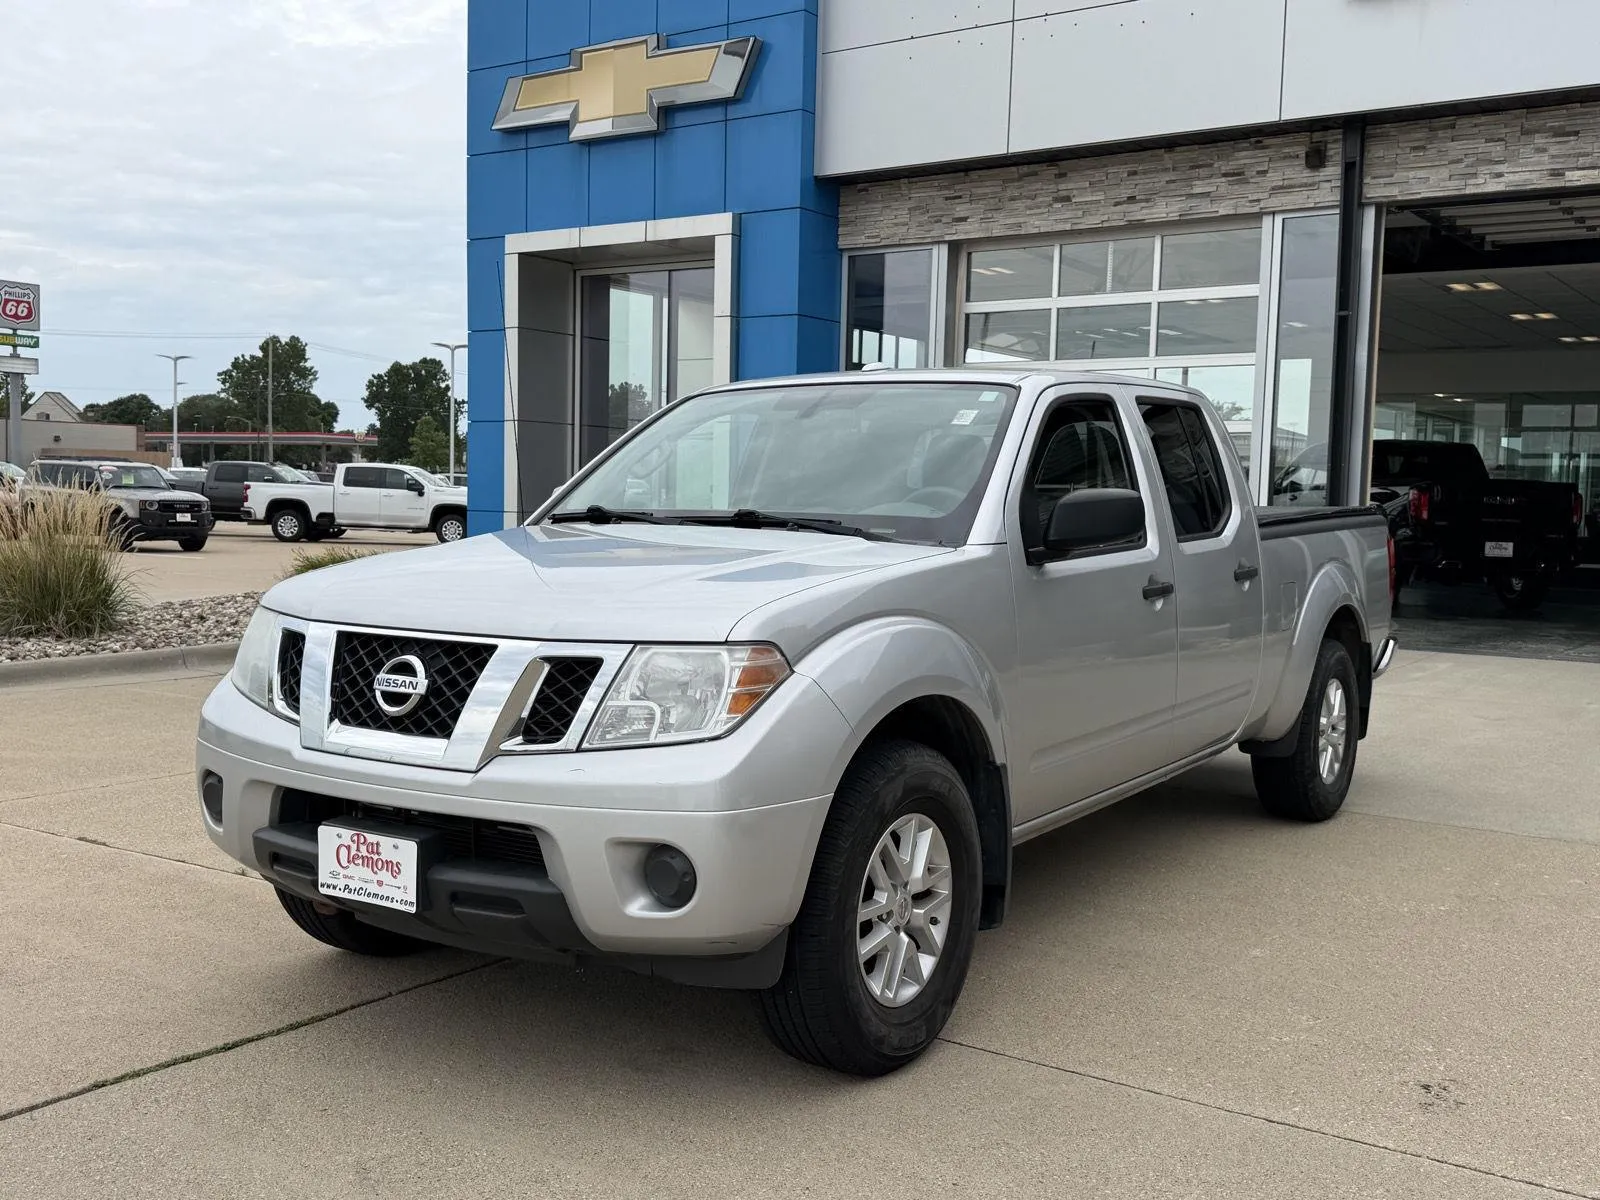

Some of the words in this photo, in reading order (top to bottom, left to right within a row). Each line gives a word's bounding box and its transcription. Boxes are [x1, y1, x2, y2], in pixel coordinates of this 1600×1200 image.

[4, 289, 31, 300] PHILLIPS
[5, 301, 29, 317] 66
[0, 335, 37, 346] SUBWAY
[375, 677, 419, 691] NISSAN
[350, 832, 381, 856] Pat
[336, 843, 402, 879] Clemons
[320, 881, 415, 908] www.PatClemons.com
